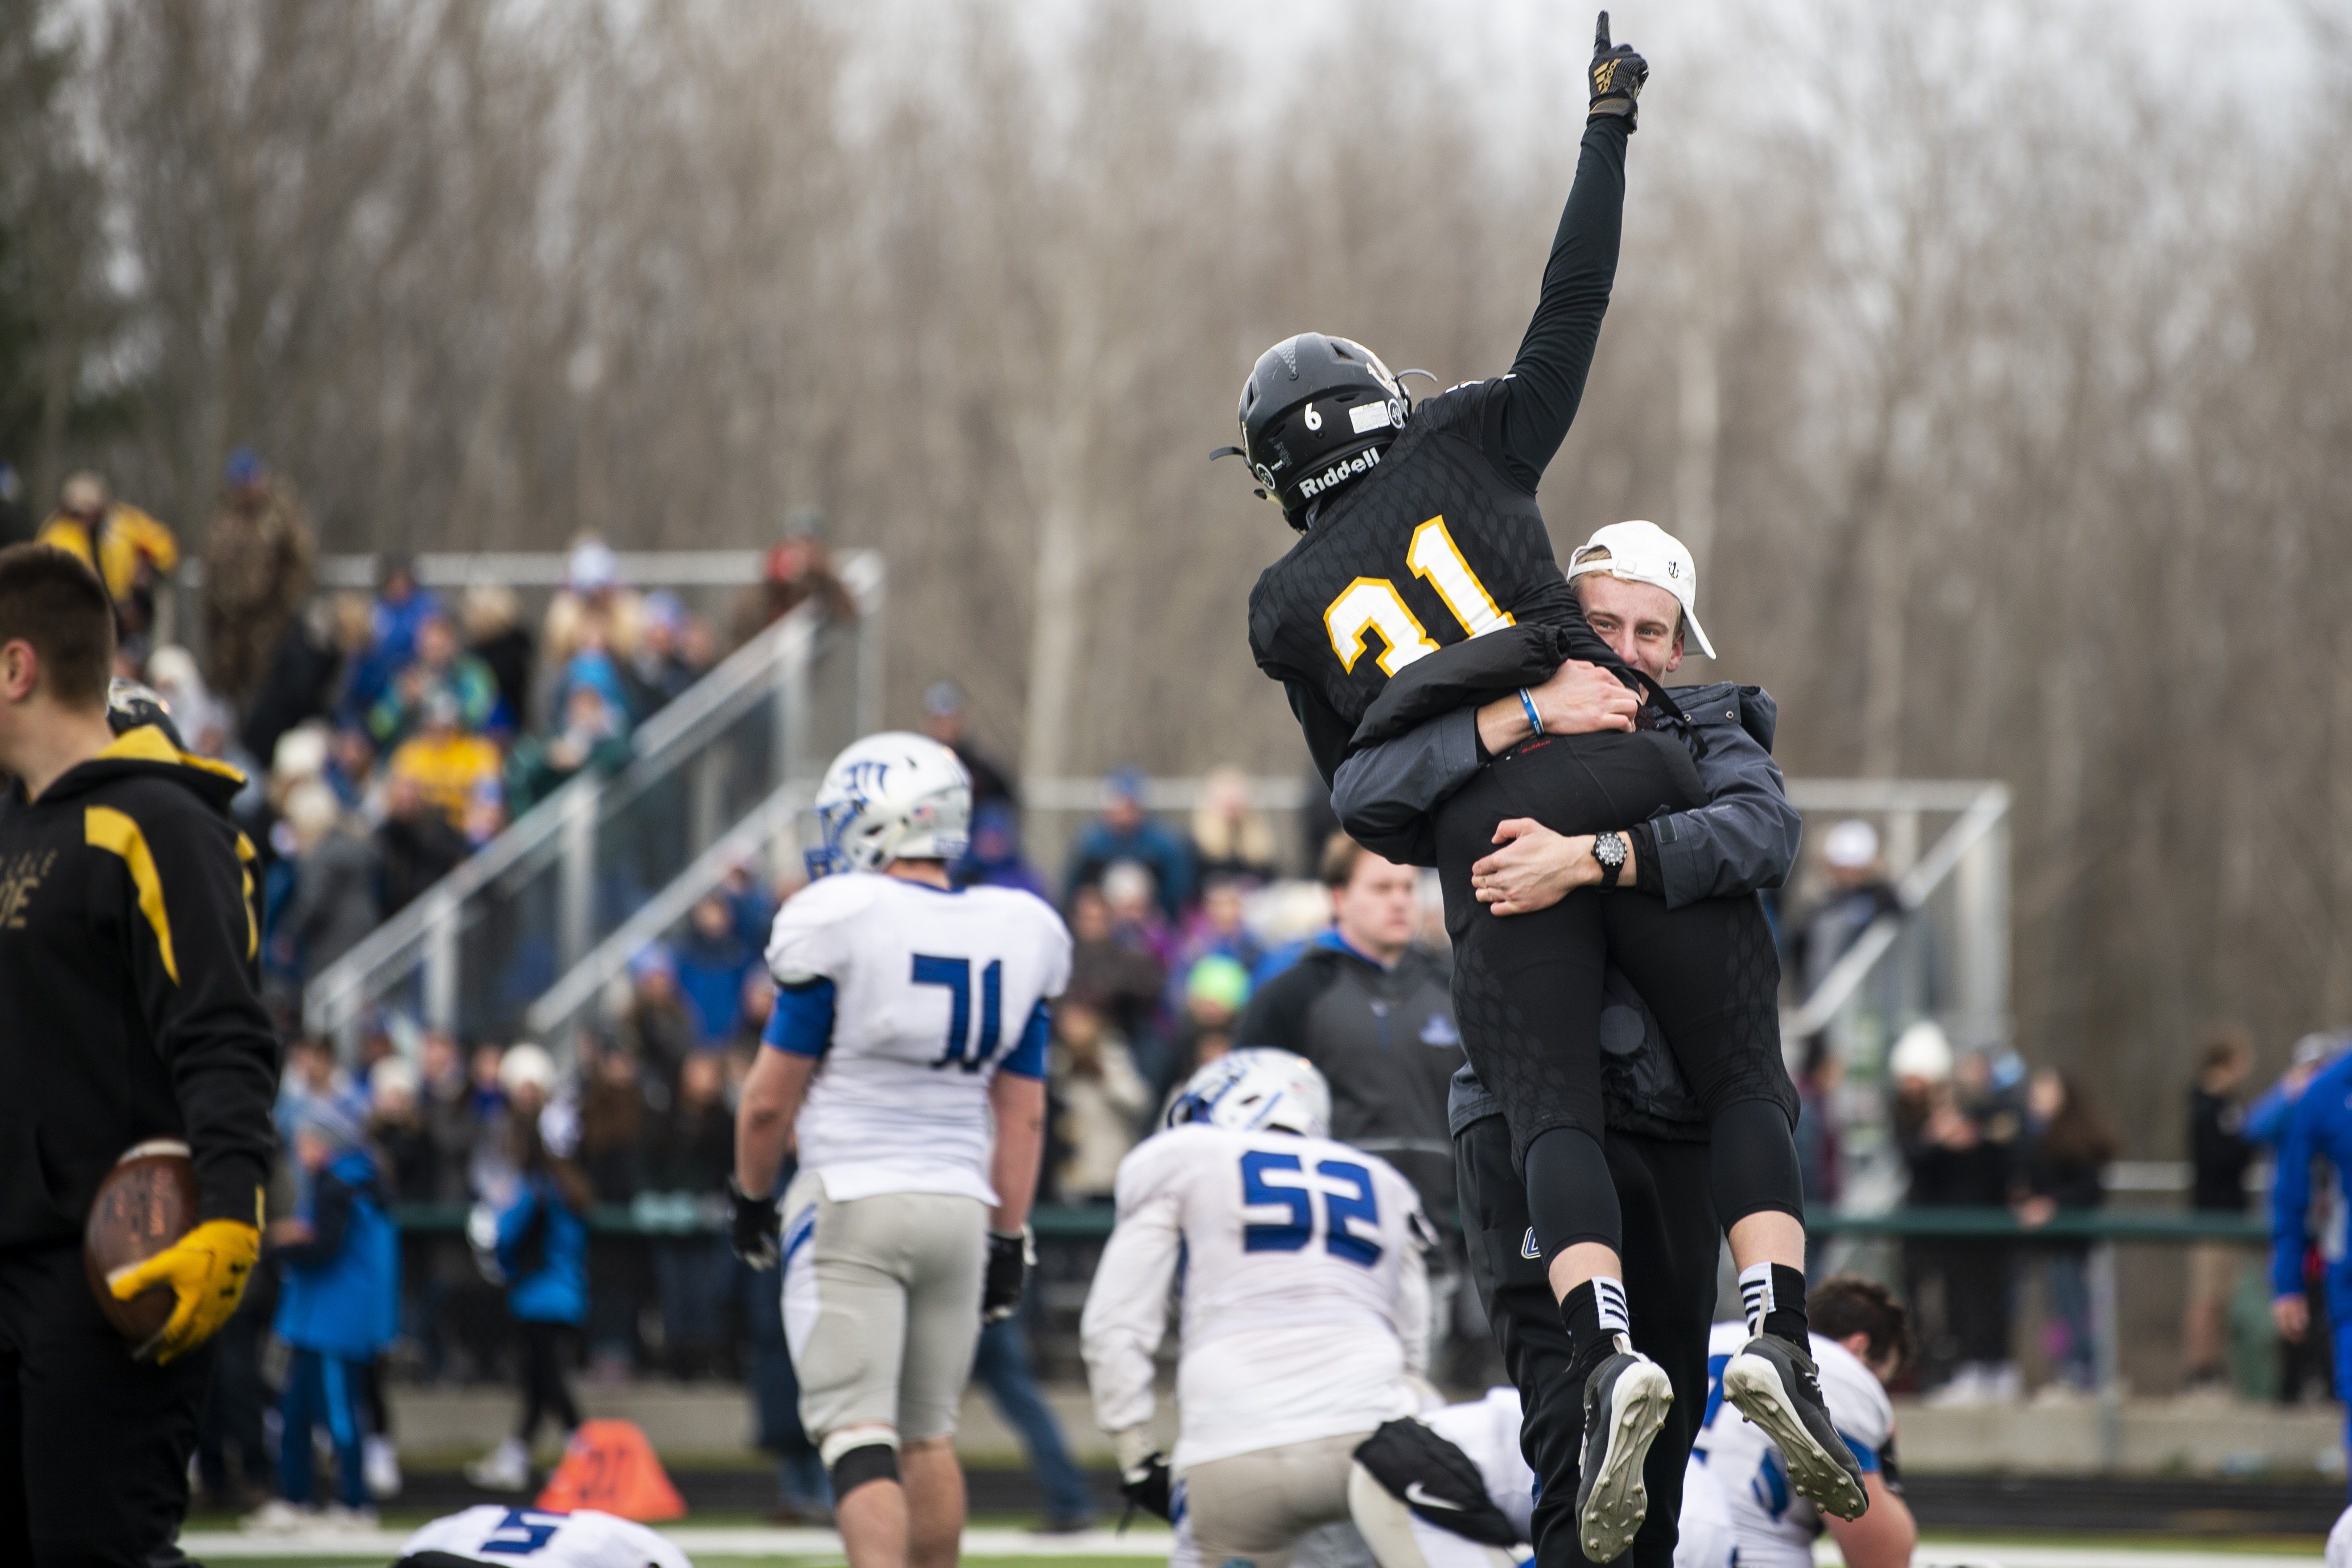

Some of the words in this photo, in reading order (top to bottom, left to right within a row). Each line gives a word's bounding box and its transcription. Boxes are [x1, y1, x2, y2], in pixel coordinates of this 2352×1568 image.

[1305, 402, 1322, 431] 6
[1299, 447, 1380, 499] Riddell
[911, 953, 1001, 1073] 71
[1240, 1150, 1384, 1268] 52
